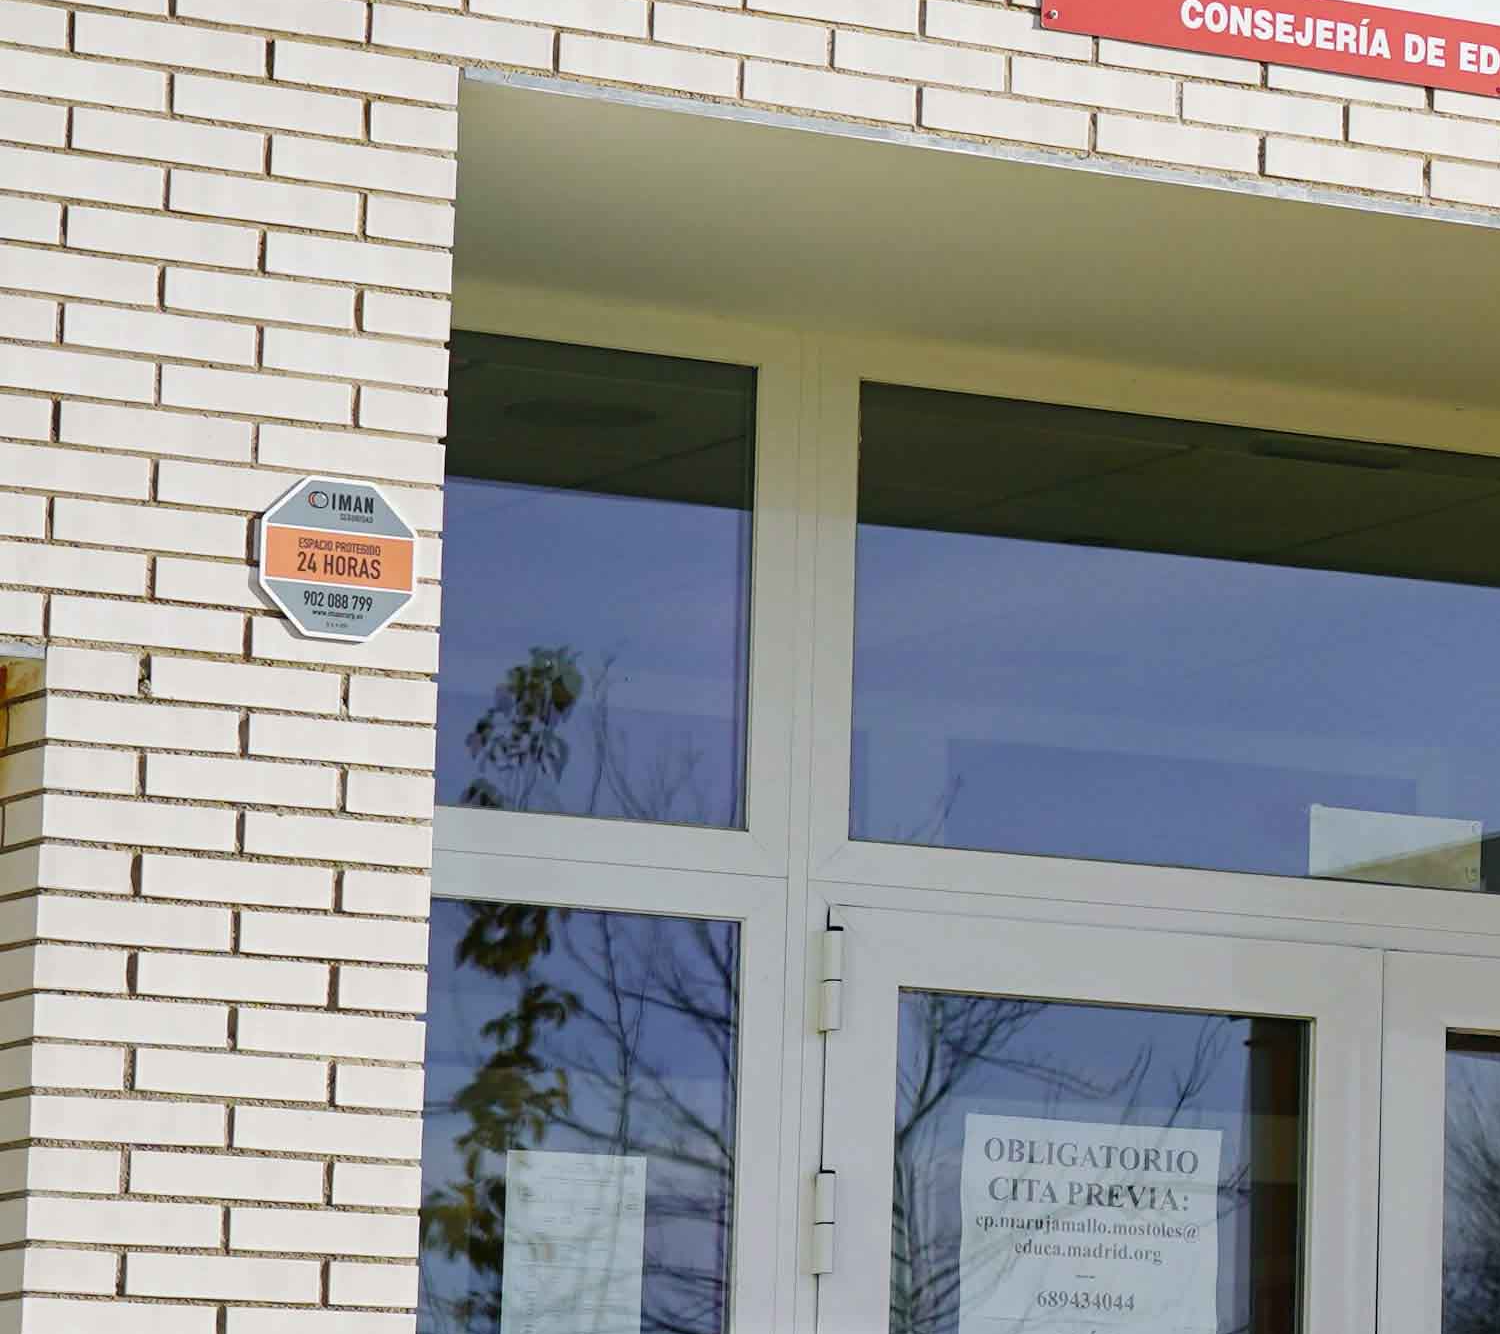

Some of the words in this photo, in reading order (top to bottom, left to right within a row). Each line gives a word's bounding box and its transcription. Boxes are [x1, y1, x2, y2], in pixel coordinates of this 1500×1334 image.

[1404, 31, 1446, 68] DE
[331, 493, 374, 514] IMAN
[298, 537, 333, 552] ESPACIO
[335, 541, 381, 557] PROTEGIDO
[297, 552, 317, 573] 24
[323, 555, 381, 580] HORAS
[304, 590, 324, 608] 902
[328, 593, 349, 610] 088
[352, 595, 373, 612] 799
[983, 1136, 1200, 1174] OBLIGATORIO
[988, 1177, 1059, 1205] CITA
[1067, 1181, 1190, 1213] PREVIA:
[975, 1213, 1200, 1240] cp.marujamallo.mostoles@
[1014, 1238, 1163, 1266] educa.madrid.org
[1036, 1290, 1136, 1312] 689434044
